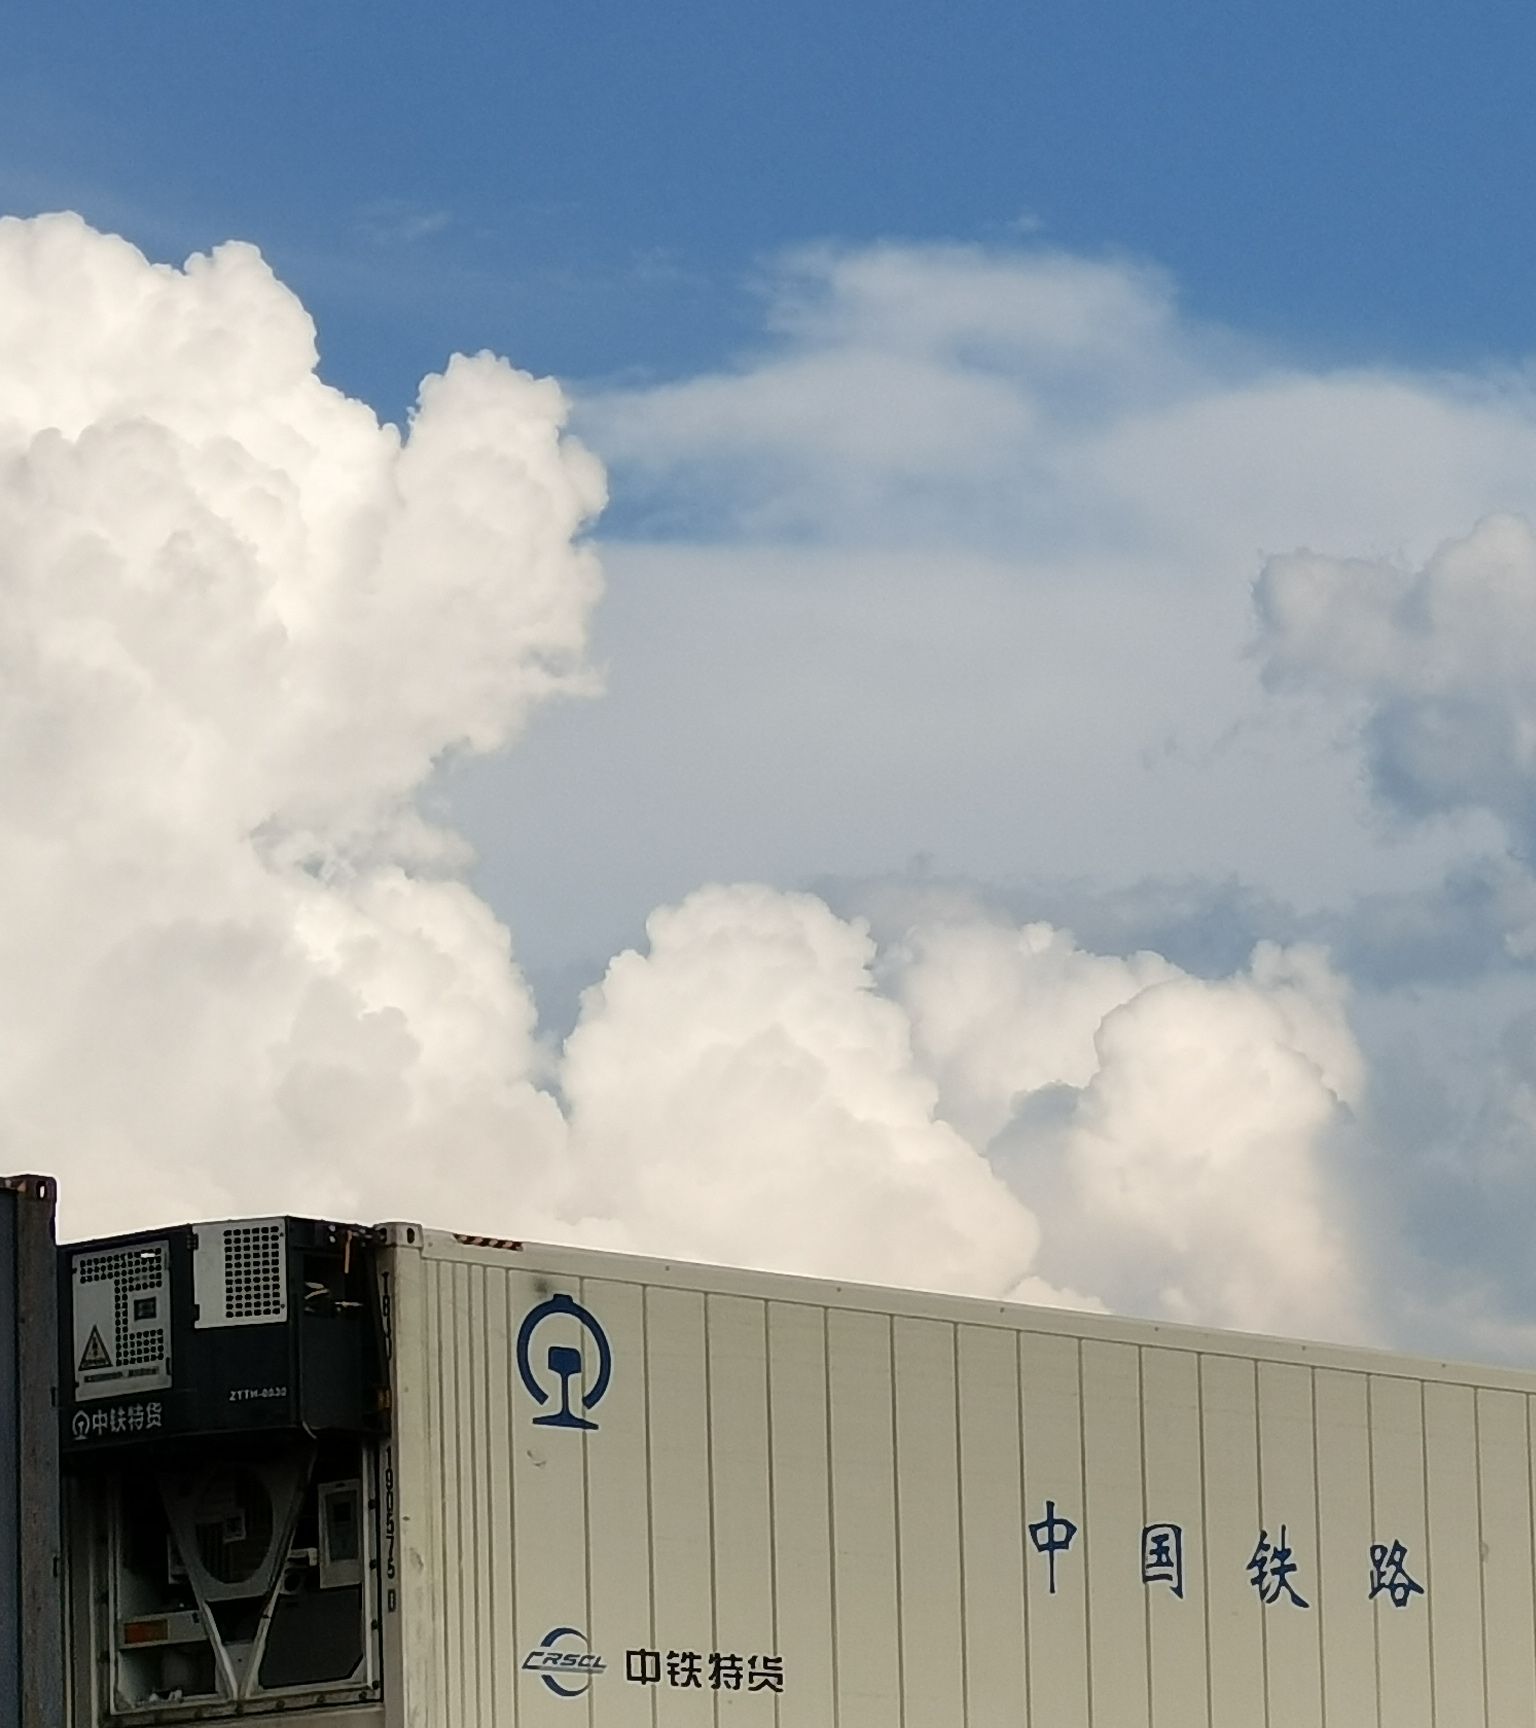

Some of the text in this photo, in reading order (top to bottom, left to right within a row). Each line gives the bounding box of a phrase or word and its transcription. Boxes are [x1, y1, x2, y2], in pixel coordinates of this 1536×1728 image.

[91, 1402, 164, 1437] 中铁特货
[1029, 1501, 1424, 1608] 中国铁路
[626, 1648, 784, 1692] 中铁特货
